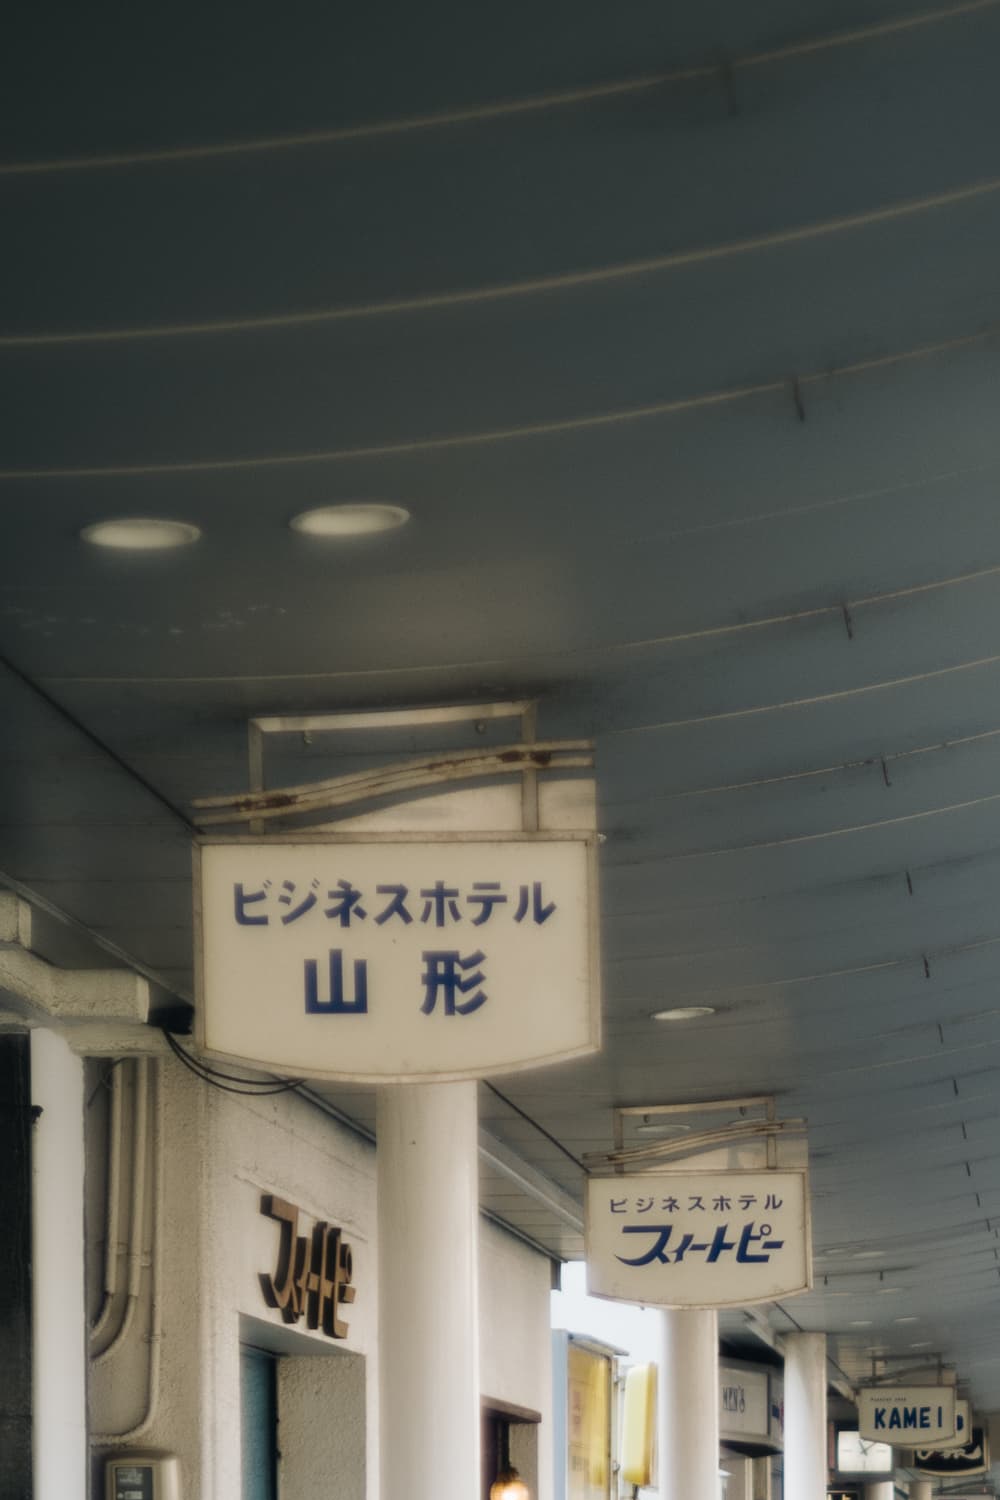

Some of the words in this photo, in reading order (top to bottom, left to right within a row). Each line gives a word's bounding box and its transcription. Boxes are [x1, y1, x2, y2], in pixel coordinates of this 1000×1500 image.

[232, 879, 557, 929] ビジネスホテル
[304, 948, 488, 1016] 山形
[609, 1193, 784, 1214] ビジネスホテル
[873, 1405, 943, 1430] KAMEI
